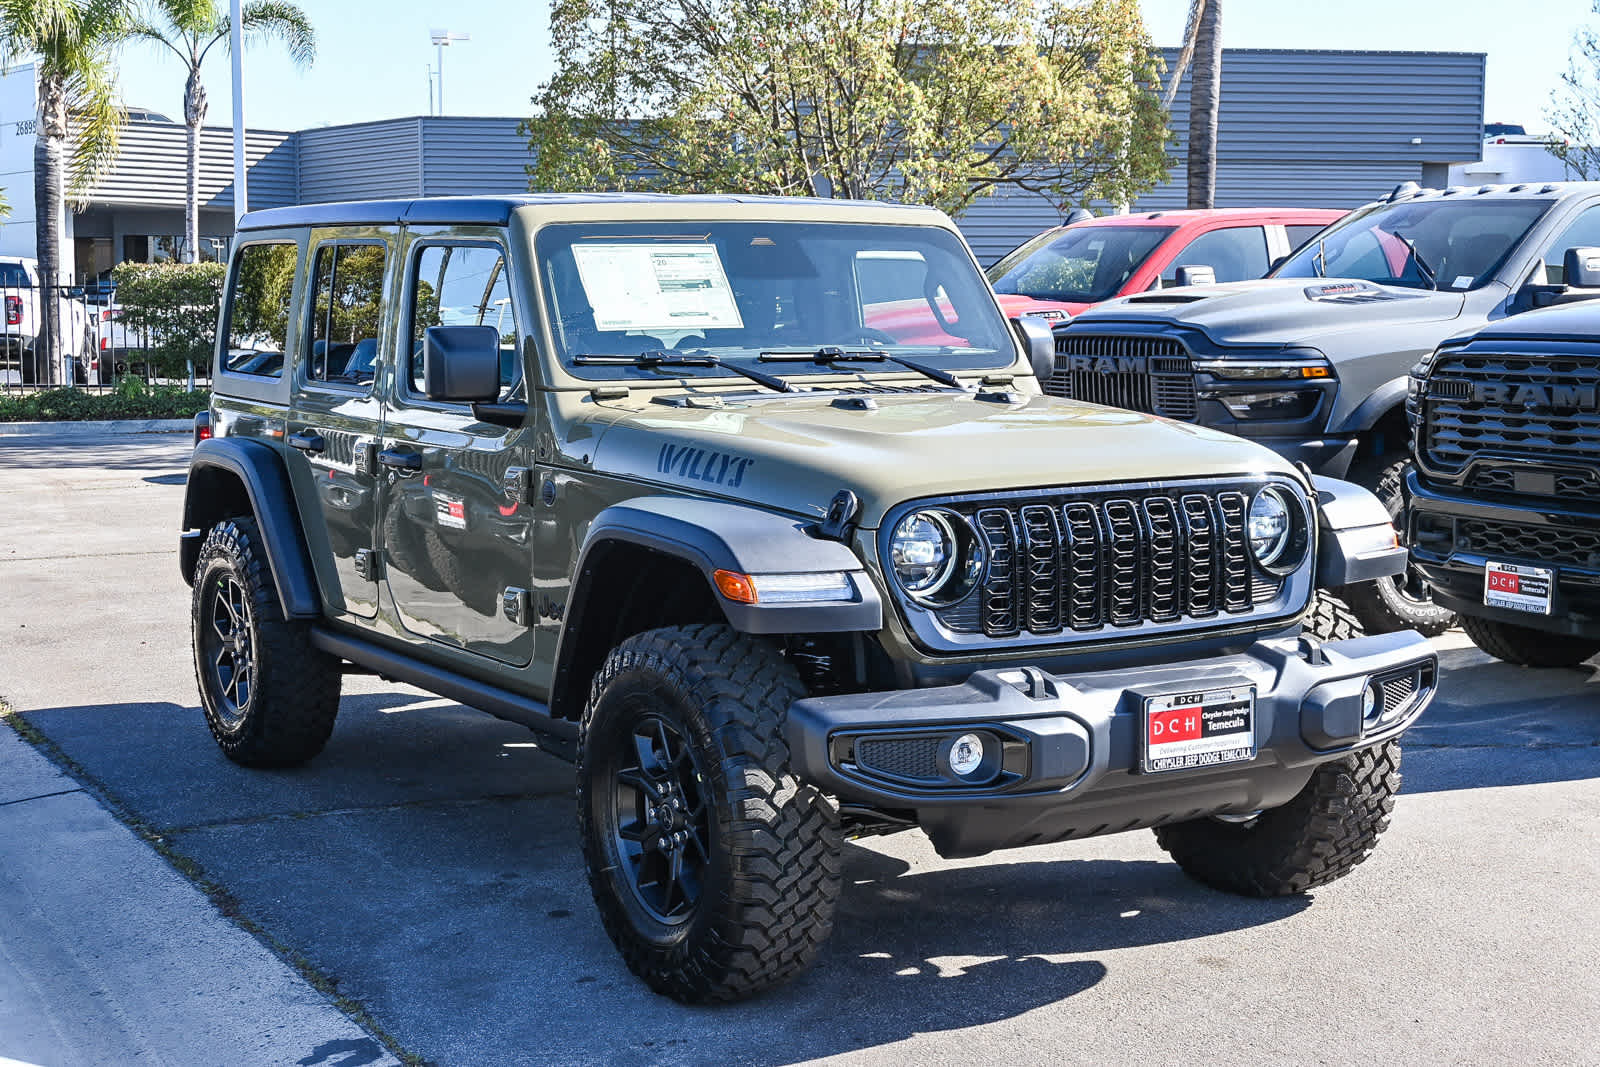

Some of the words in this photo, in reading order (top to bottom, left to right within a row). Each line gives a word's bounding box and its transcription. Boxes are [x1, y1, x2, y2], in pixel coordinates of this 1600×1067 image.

[1070, 356, 1147, 374] RAM
[1474, 381, 1596, 408] RAM
[657, 443, 755, 488] WILLYS
[1491, 576, 1515, 589] DCH
[1180, 695, 1200, 704] DCH
[1153, 716, 1195, 736] DCH
[1207, 716, 1245, 731] Temecula
[1153, 756, 1184, 770] CHRYSLER
[1184, 755, 1197, 767] JEEP
[1199, 752, 1220, 765] DODGE
[1220, 747, 1251, 761] TEMECULA
